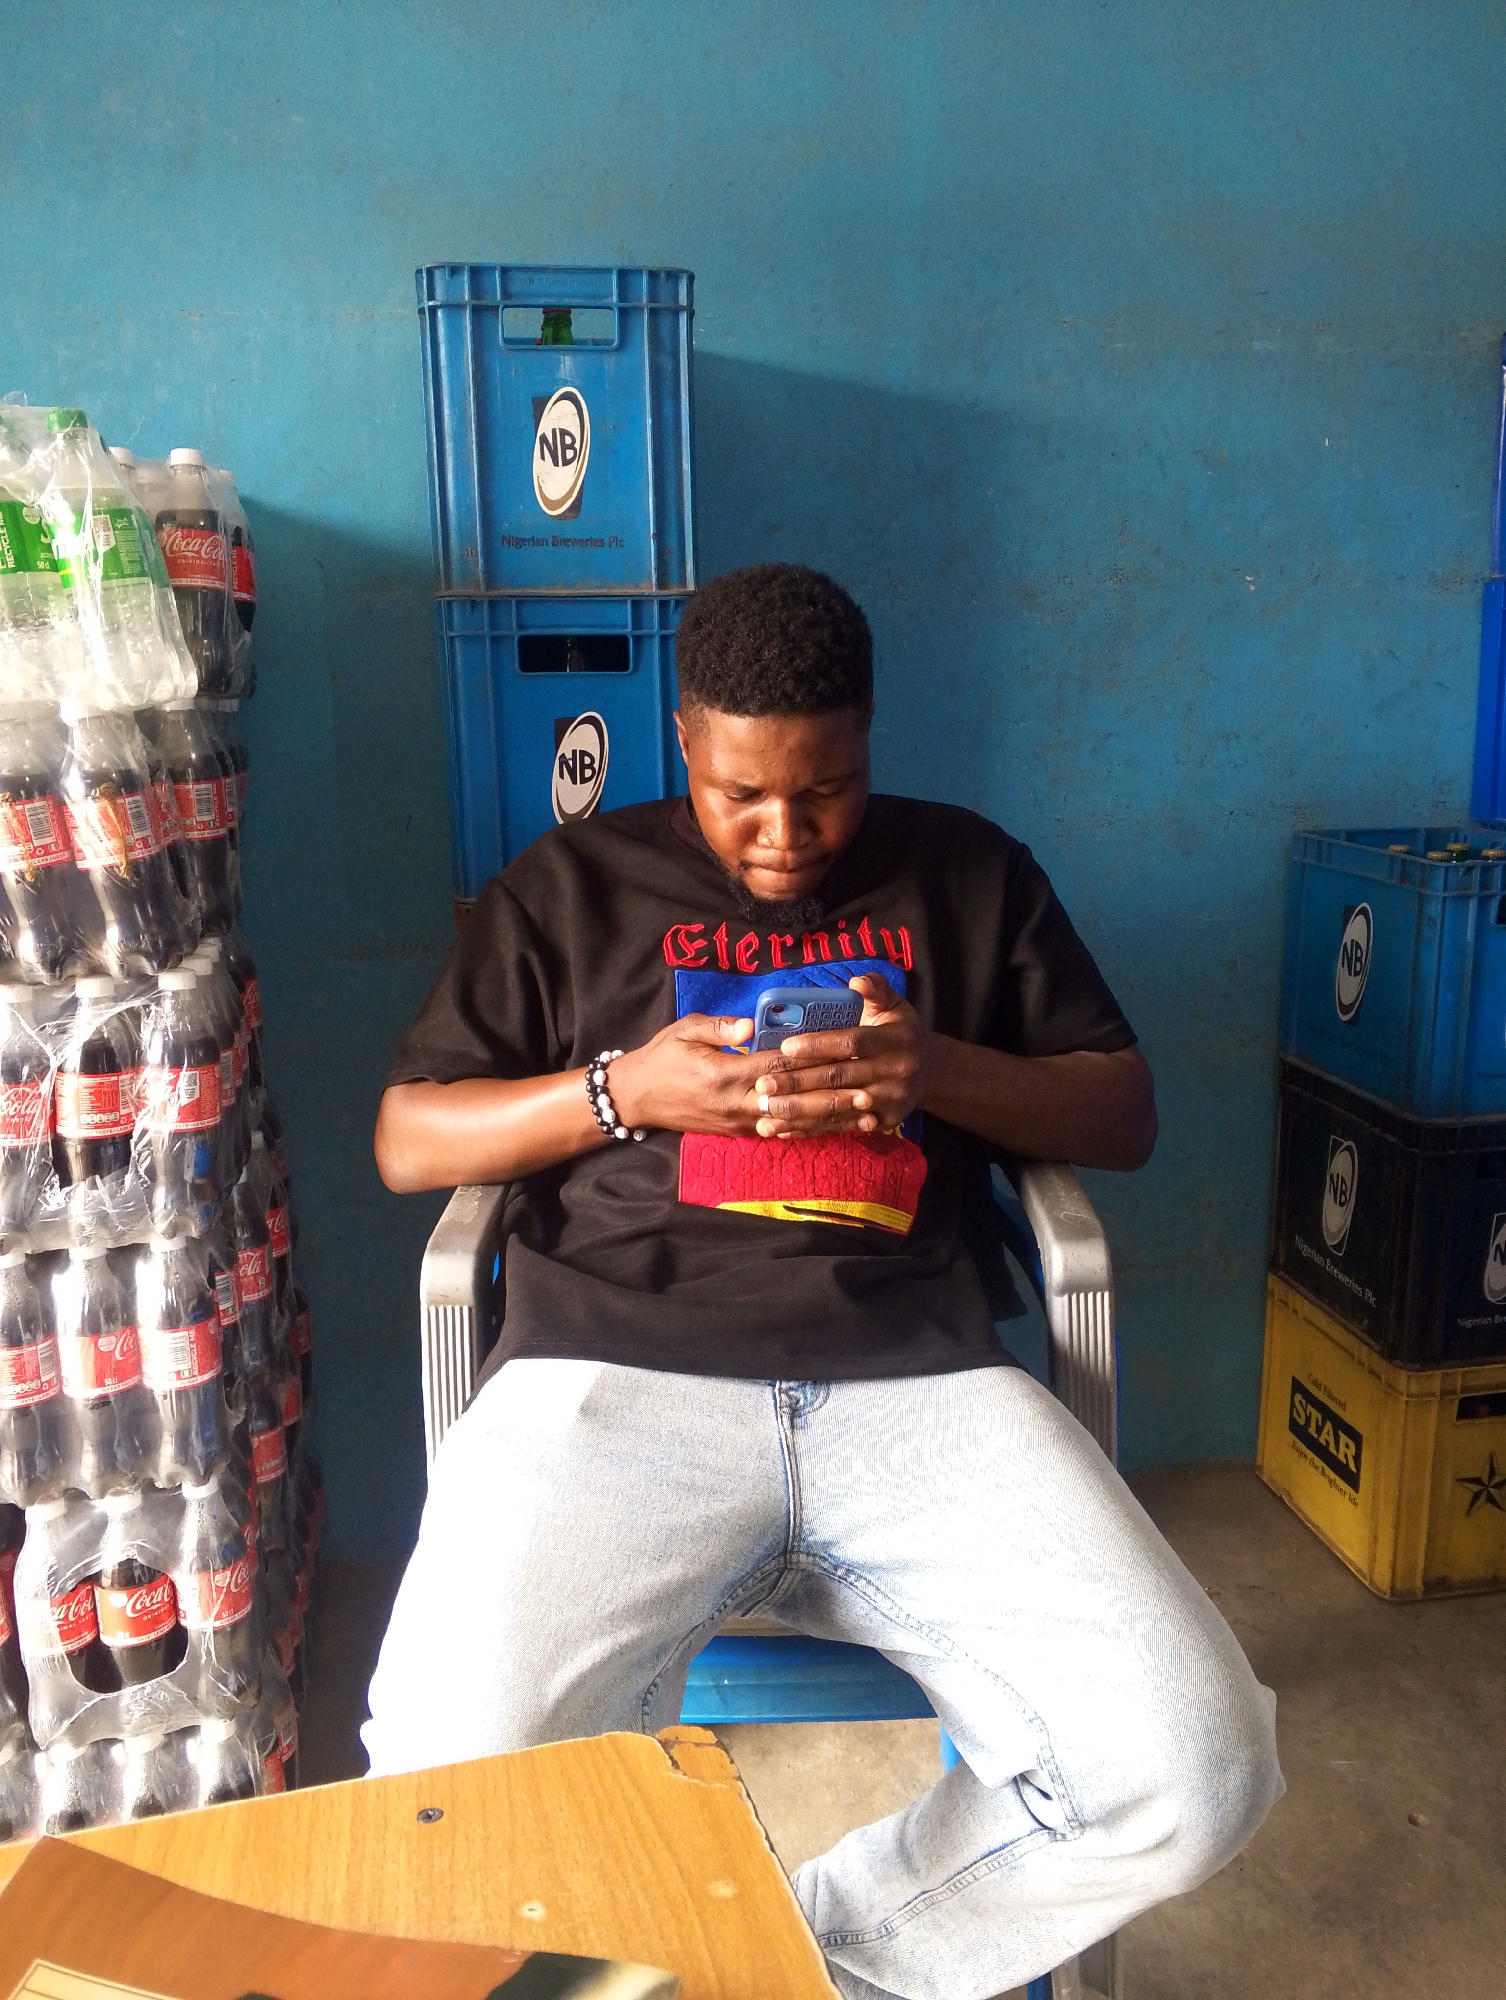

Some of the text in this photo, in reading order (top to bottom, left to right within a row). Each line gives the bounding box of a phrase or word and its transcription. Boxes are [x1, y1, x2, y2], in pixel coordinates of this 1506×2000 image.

[539, 428, 578, 467] NB
[0, 526, 16, 568] RECYCLE
[501, 534, 625, 550] Nigerian Breweries Plc
[558, 748, 597, 786] NB
[663, 916, 914, 973] Eternity
[1341, 938, 1364, 978] NB
[1328, 1173, 1349, 1208] NB
[1295, 1234, 1377, 1308] Nigerian Breweries Plc
[1458, 1316, 1492, 1329] Nigerian
[188, 1329, 199, 1376] RECYCLE ME
[1308, 1373, 1347, 1411] Cold Filtered
[1293, 1393, 1358, 1474] STAR
[1309, 1455, 1321, 1473] the
[1320, 1465, 1347, 1499] Brighter
[1348, 1493, 1359, 1508] life
